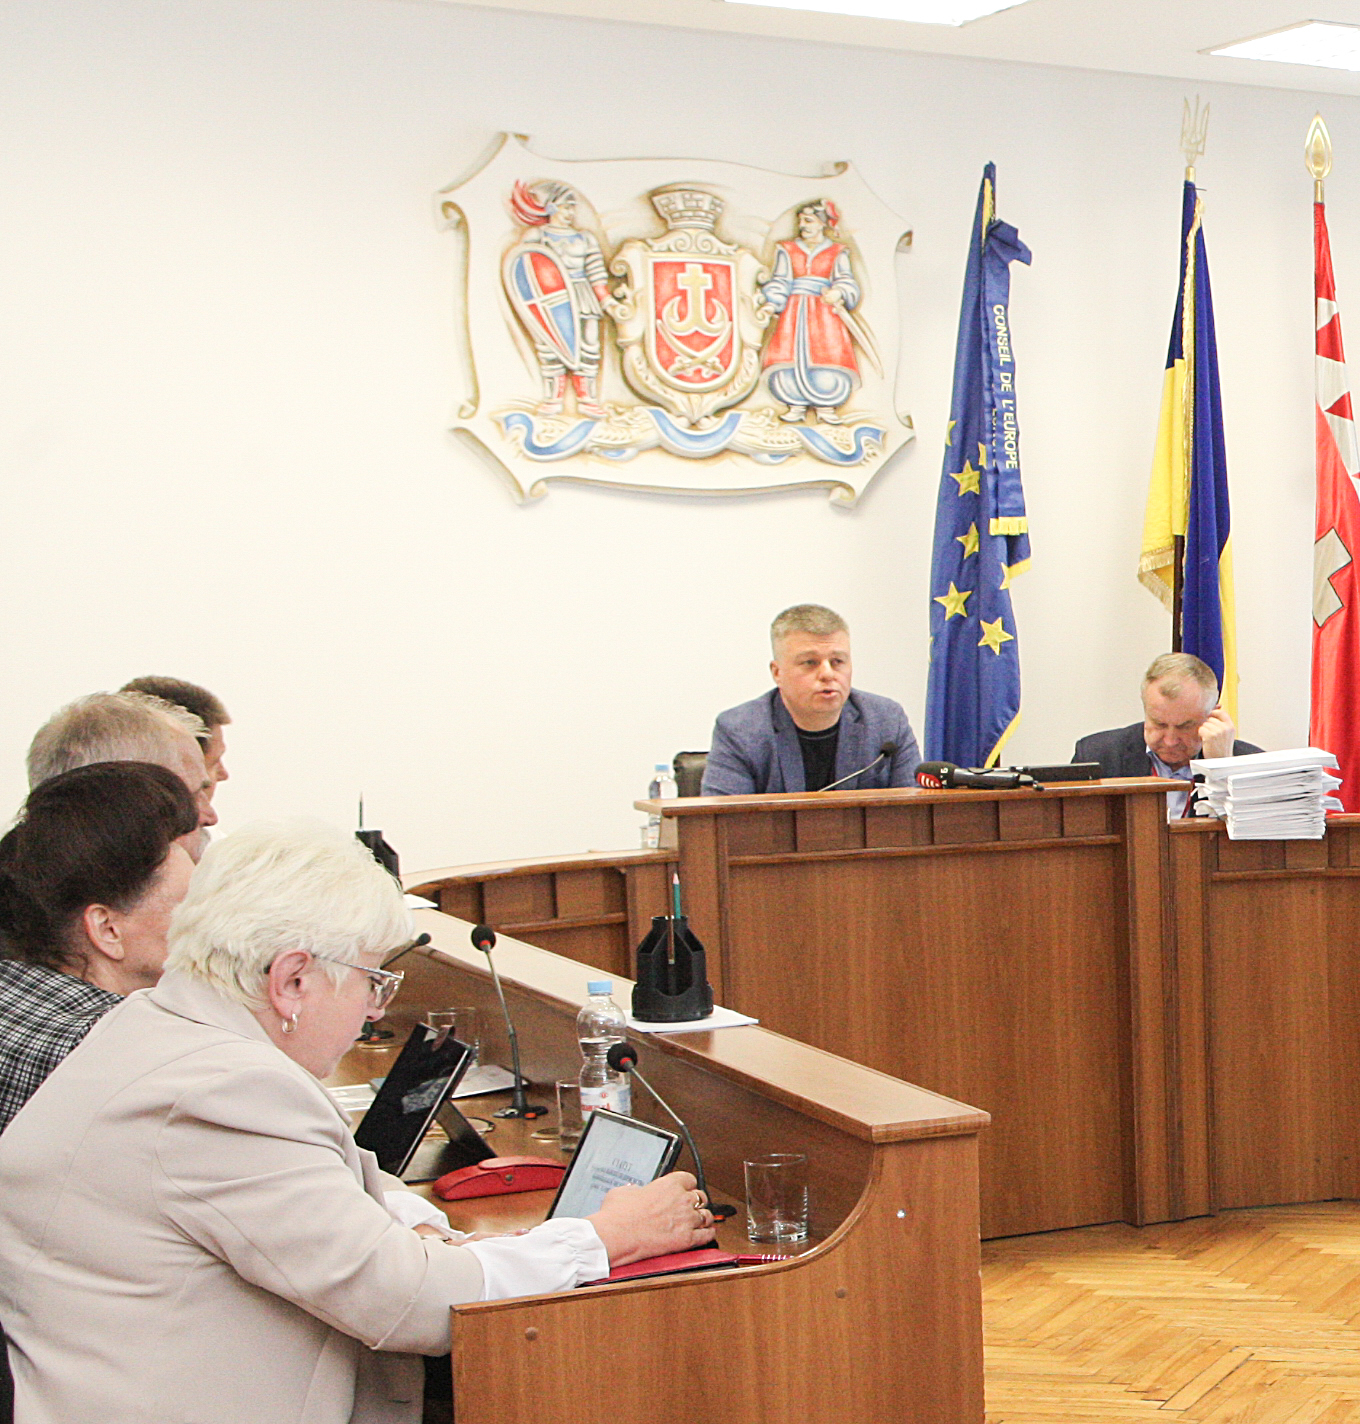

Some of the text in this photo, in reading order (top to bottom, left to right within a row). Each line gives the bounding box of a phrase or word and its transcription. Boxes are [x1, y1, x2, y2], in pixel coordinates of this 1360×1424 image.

[993, 304, 1019, 470] CONSEIL DE L'EUROPE
